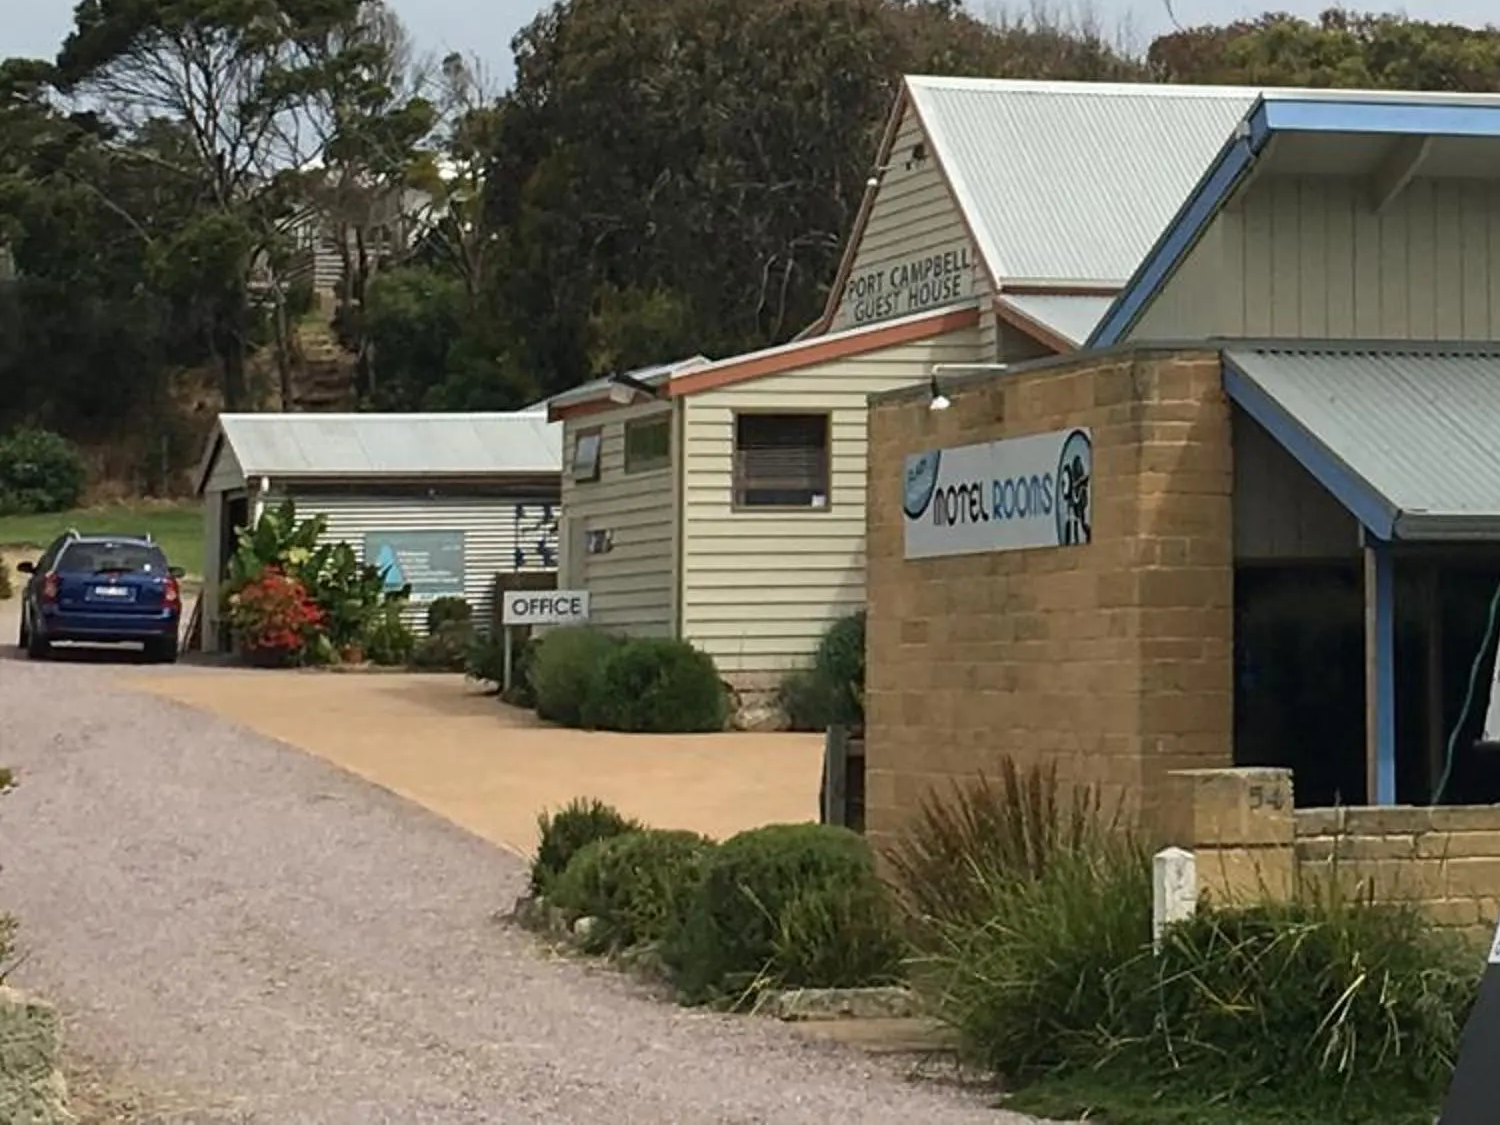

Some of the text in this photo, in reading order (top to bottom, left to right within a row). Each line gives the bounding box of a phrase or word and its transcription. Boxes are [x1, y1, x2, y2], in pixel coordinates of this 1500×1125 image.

[889, 248, 971, 289] CAMPBELL
[854, 274, 961, 322] GUEST HOUSE
[933, 472, 1054, 527] MOTEL ROOMS
[512, 597, 582, 616] OFFICE
